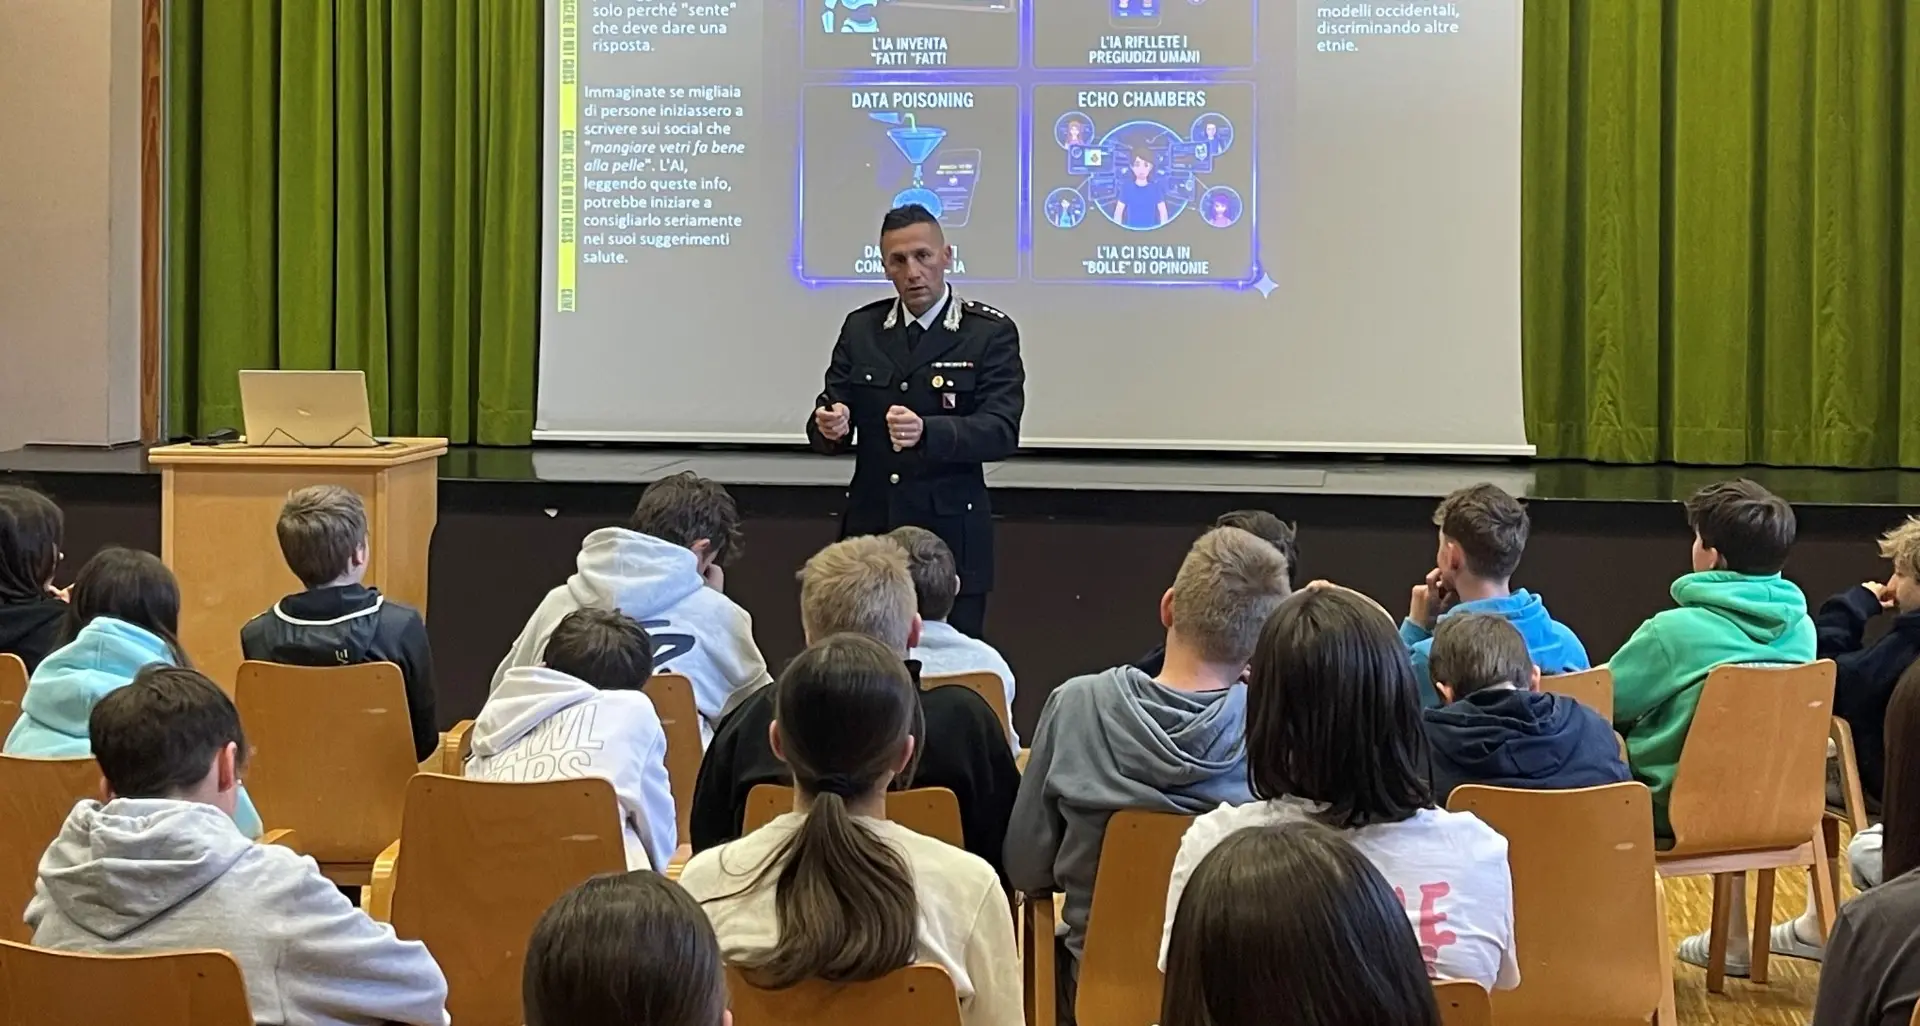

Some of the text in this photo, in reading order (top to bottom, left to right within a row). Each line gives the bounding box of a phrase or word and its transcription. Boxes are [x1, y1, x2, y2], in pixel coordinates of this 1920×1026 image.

[593, 2, 736, 18] solo perché "sente"
[1318, 3, 1459, 18] modelli occidentali,
[593, 20, 726, 34] che deve dare una
[1317, 20, 1458, 34] discriminando altre
[593, 39, 654, 53] risposta.
[873, 37, 947, 50] L'IA INVENTA
[1101, 35, 1187, 48] L'IA RIFLLETE I
[1317, 39, 1358, 51] etnie.
[1089, 50, 1200, 64] PREGIUDIZI UMANI
[585, 85, 740, 100] Immaginate se migliaia
[1079, 91, 1205, 107] ECHO CHAMBERS
[852, 92, 973, 108] DATA POISONING
[585, 104, 743, 119] di persone iniziassero a
[584, 122, 730, 134] scrivere sui social che
[660, 142, 691, 153] vetri
[692, 140, 709, 156] fa
[711, 141, 745, 154] bene
[584, 159, 608, 171] alla
[584, 176, 731, 192] leggendo queste info,
[584, 195, 712, 211] potrebbe iniziare a
[584, 213, 741, 229] consigliarlo seriamente
[584, 233, 729, 248] nei suoi suggerimenti
[584, 250, 628, 263] salute.
[1097, 246, 1190, 259] L'IA CI ISOLA IN
[1134, 261, 1146, 273] DI
[1150, 261, 1208, 274] OPINONIE
